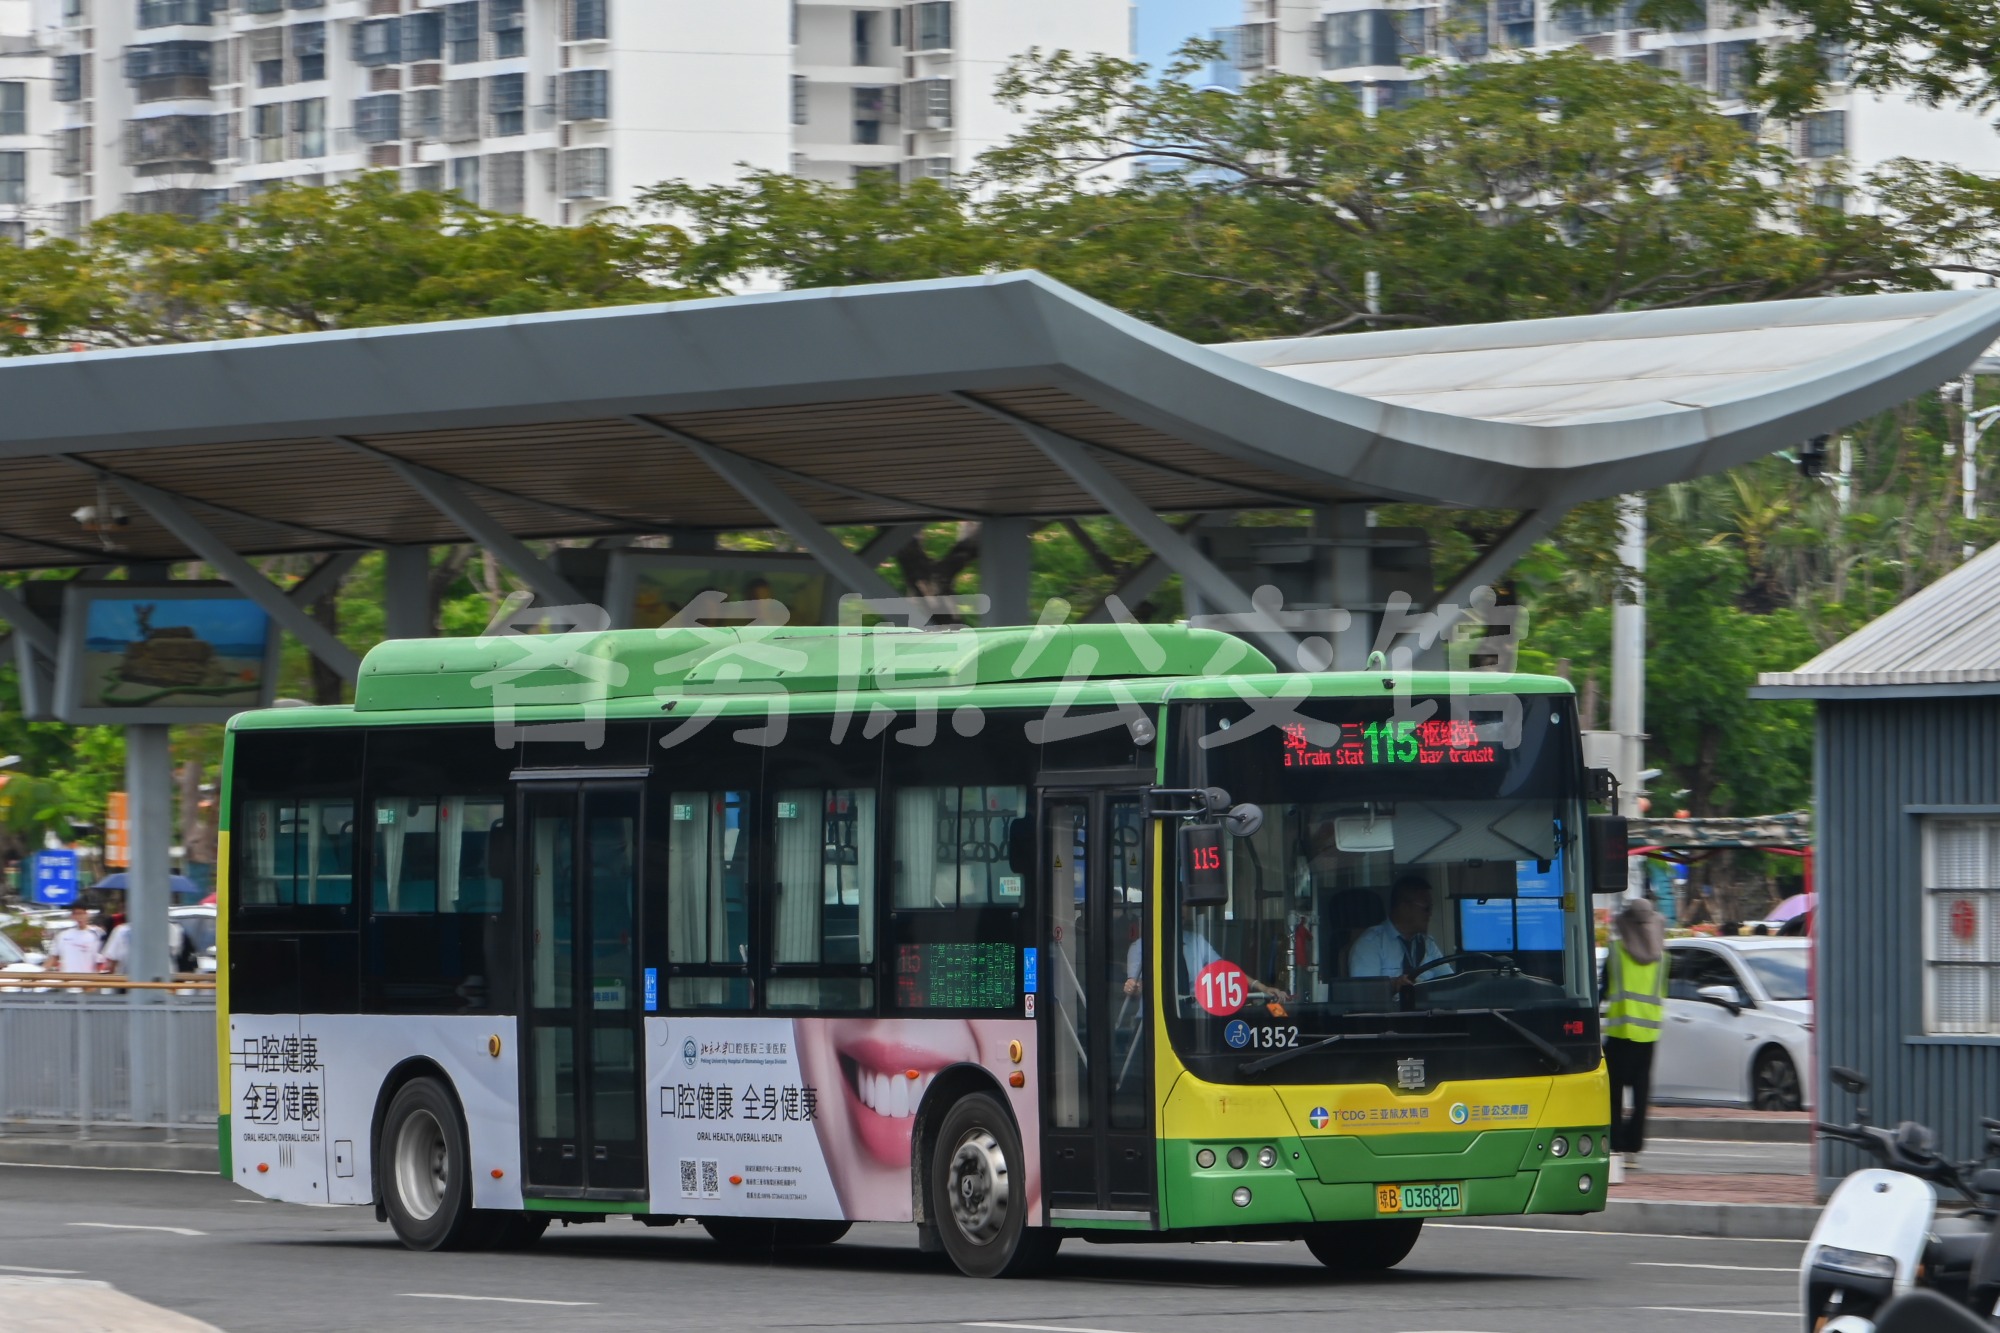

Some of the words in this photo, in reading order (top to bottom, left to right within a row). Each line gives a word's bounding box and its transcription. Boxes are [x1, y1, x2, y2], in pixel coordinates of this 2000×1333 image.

[1363, 721, 1418, 763] 115
[1296, 749, 1333, 766] Train
[1419, 748, 1444, 764] bay
[1449, 746, 1495, 763] transit
[1193, 846, 1220, 869] 115
[1201, 971, 1242, 1008] 115
[1250, 1025, 1299, 1048] 1352
[243, 1034, 318, 1073] 口腔健康
[243, 1081, 319, 1122] 全身健康
[660, 1082, 734, 1121] 口腔健康
[741, 1083, 818, 1122] 全身健康
[1472, 1104, 1529, 1116] 三亚公交集团
[243, 1133, 256, 1141] ORAL
[278, 1133, 300, 1142] OVERALL
[300, 1133, 320, 1142] HEALTH
[696, 1131, 712, 1141] ORAL
[712, 1132, 735, 1142] HEALTH,
[735, 1132, 760, 1142] OVERALL
[761, 1133, 783, 1142] HEALTH
